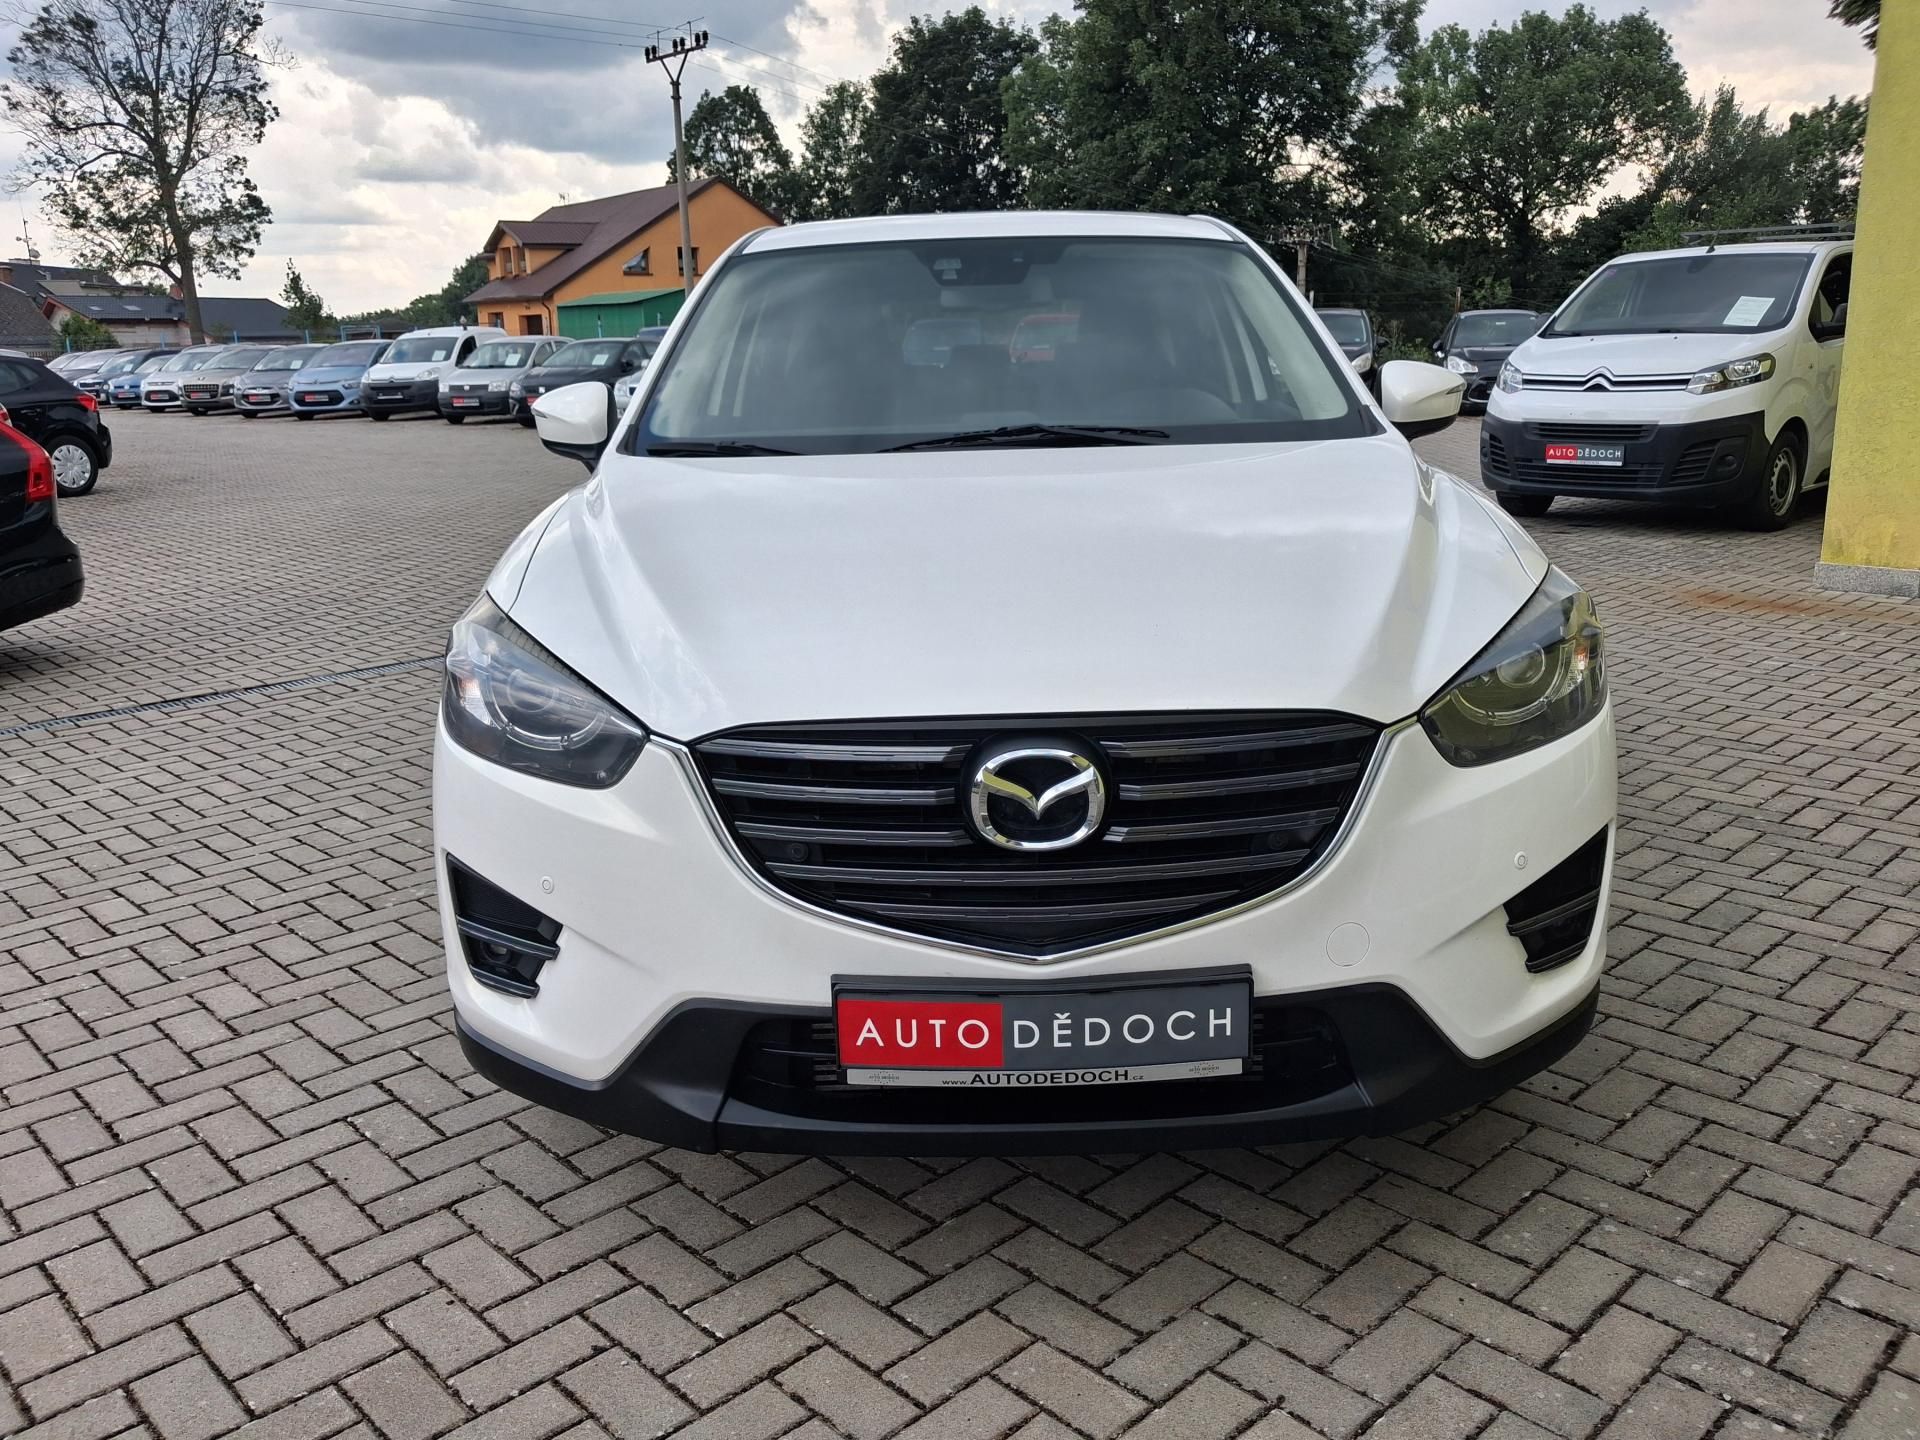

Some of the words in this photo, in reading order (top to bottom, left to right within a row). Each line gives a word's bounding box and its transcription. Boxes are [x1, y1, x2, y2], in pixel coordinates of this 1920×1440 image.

[1548, 449, 1575, 457] AUTO
[856, 1018, 989, 1049] AUTO
[1013, 1008, 1232, 1048] DĚDOCH
[942, 1070, 1145, 1085] www.AUTODEDOCH.cz
